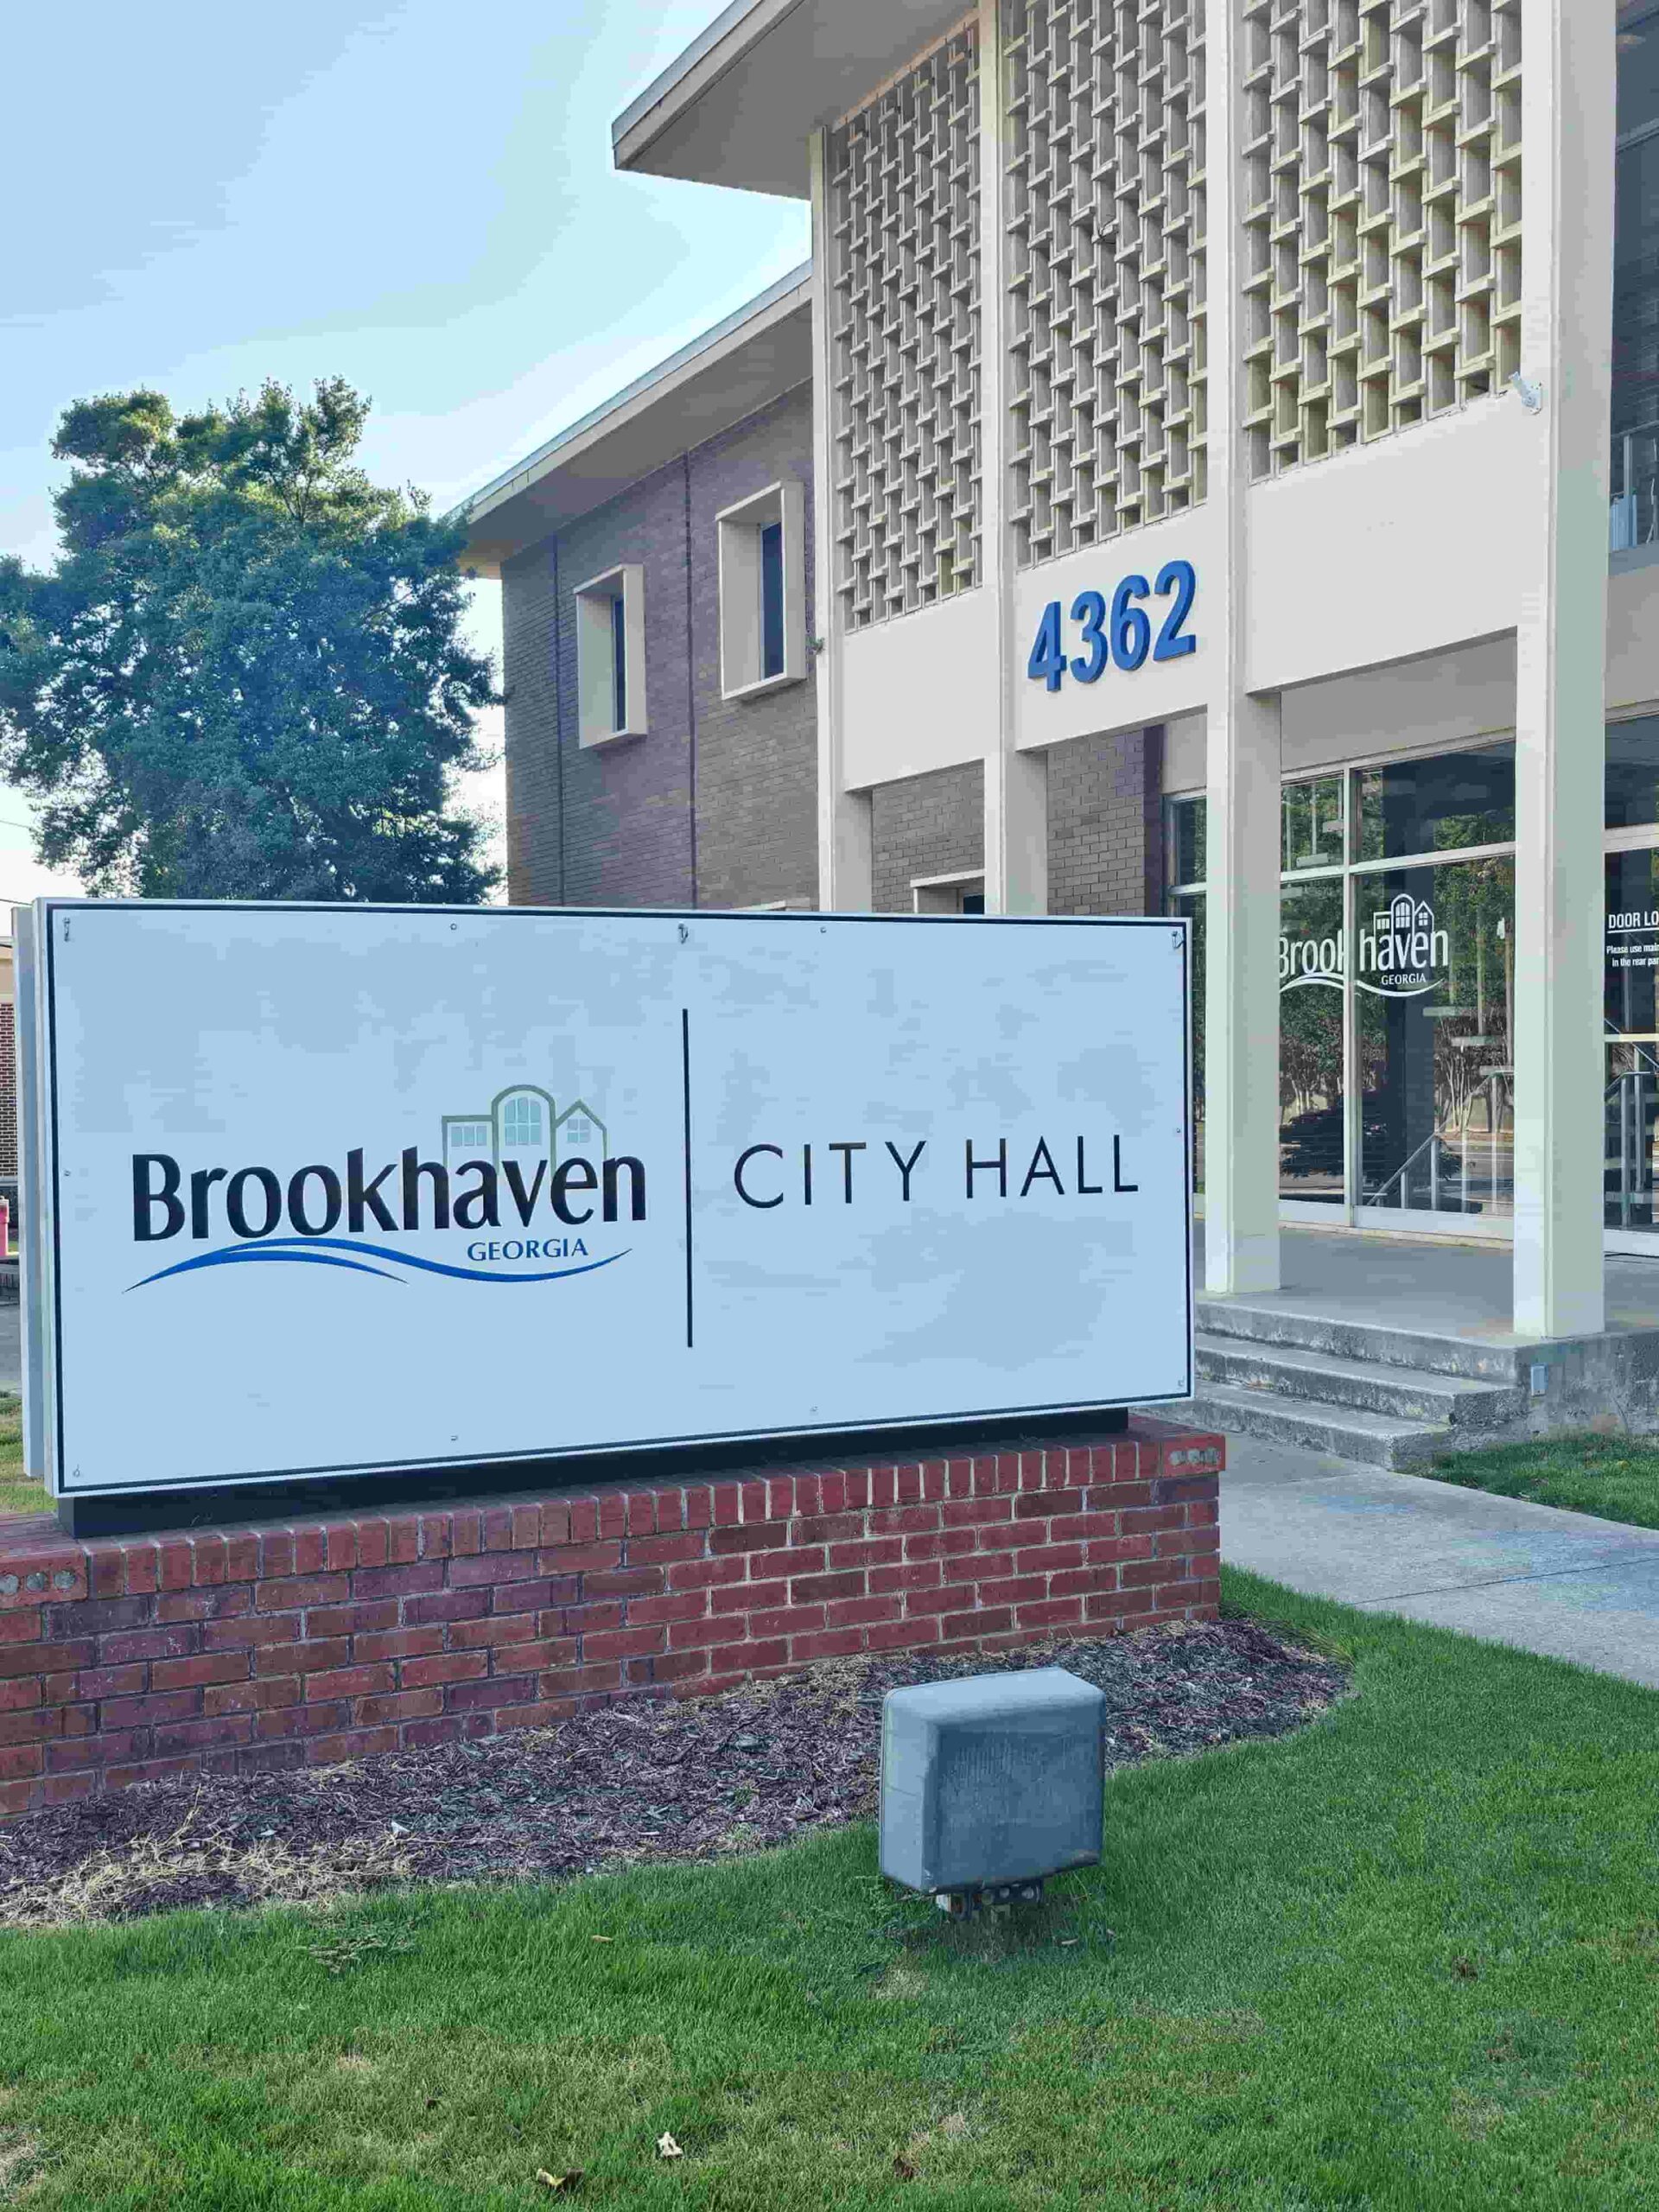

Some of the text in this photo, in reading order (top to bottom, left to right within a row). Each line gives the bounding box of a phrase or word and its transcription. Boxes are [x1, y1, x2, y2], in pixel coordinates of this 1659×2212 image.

[1027, 560, 1196, 691] 4362
[1609, 911, 1659, 929] DOOR LO
[1606, 945, 1629, 955] Please
[1620, 957, 1631, 967] the
[1381, 973, 1427, 985] GEORGIA
[734, 1135, 1139, 1209] CITY HALL
[132, 1146, 646, 1242] Brookhaven
[467, 1238, 589, 1262] GEORGIA
